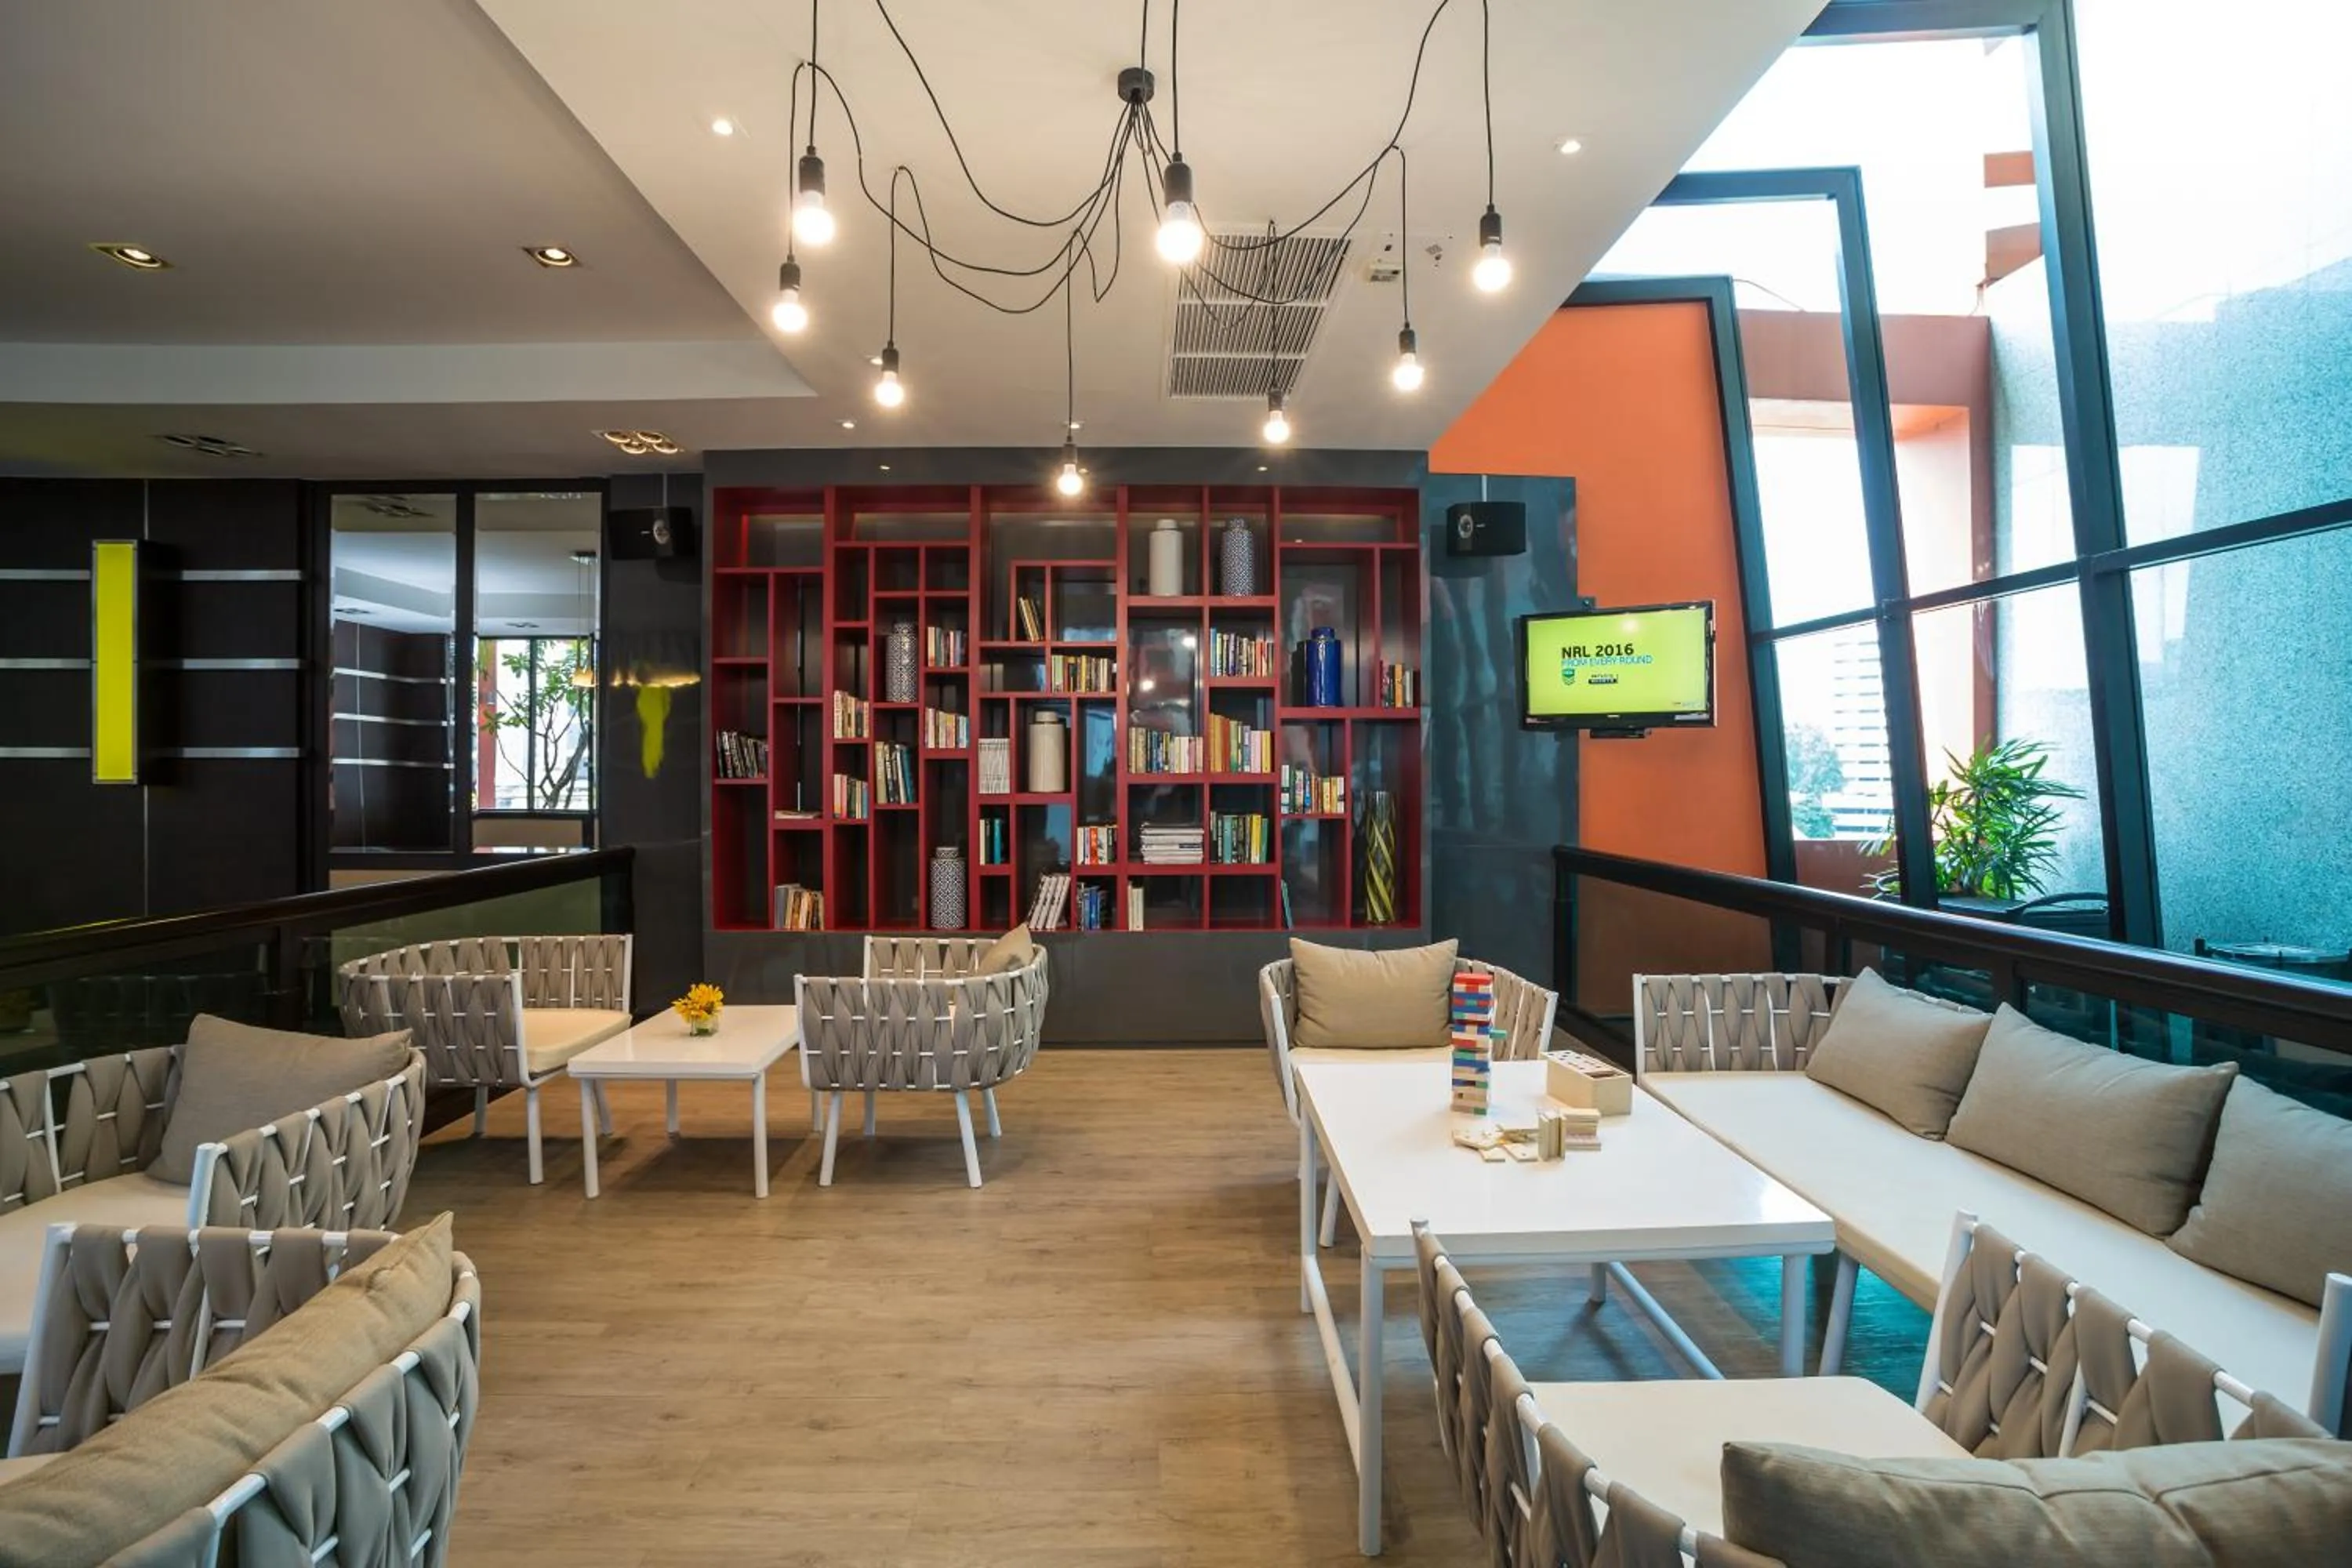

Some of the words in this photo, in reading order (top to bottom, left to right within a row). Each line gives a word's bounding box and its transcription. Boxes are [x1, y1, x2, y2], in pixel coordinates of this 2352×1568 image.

[1562, 645, 1590, 659] NRL
[1595, 643, 1634, 656] 2016
[1589, 656, 1617, 666] EVERY
[1620, 655, 1653, 664] ROUND
